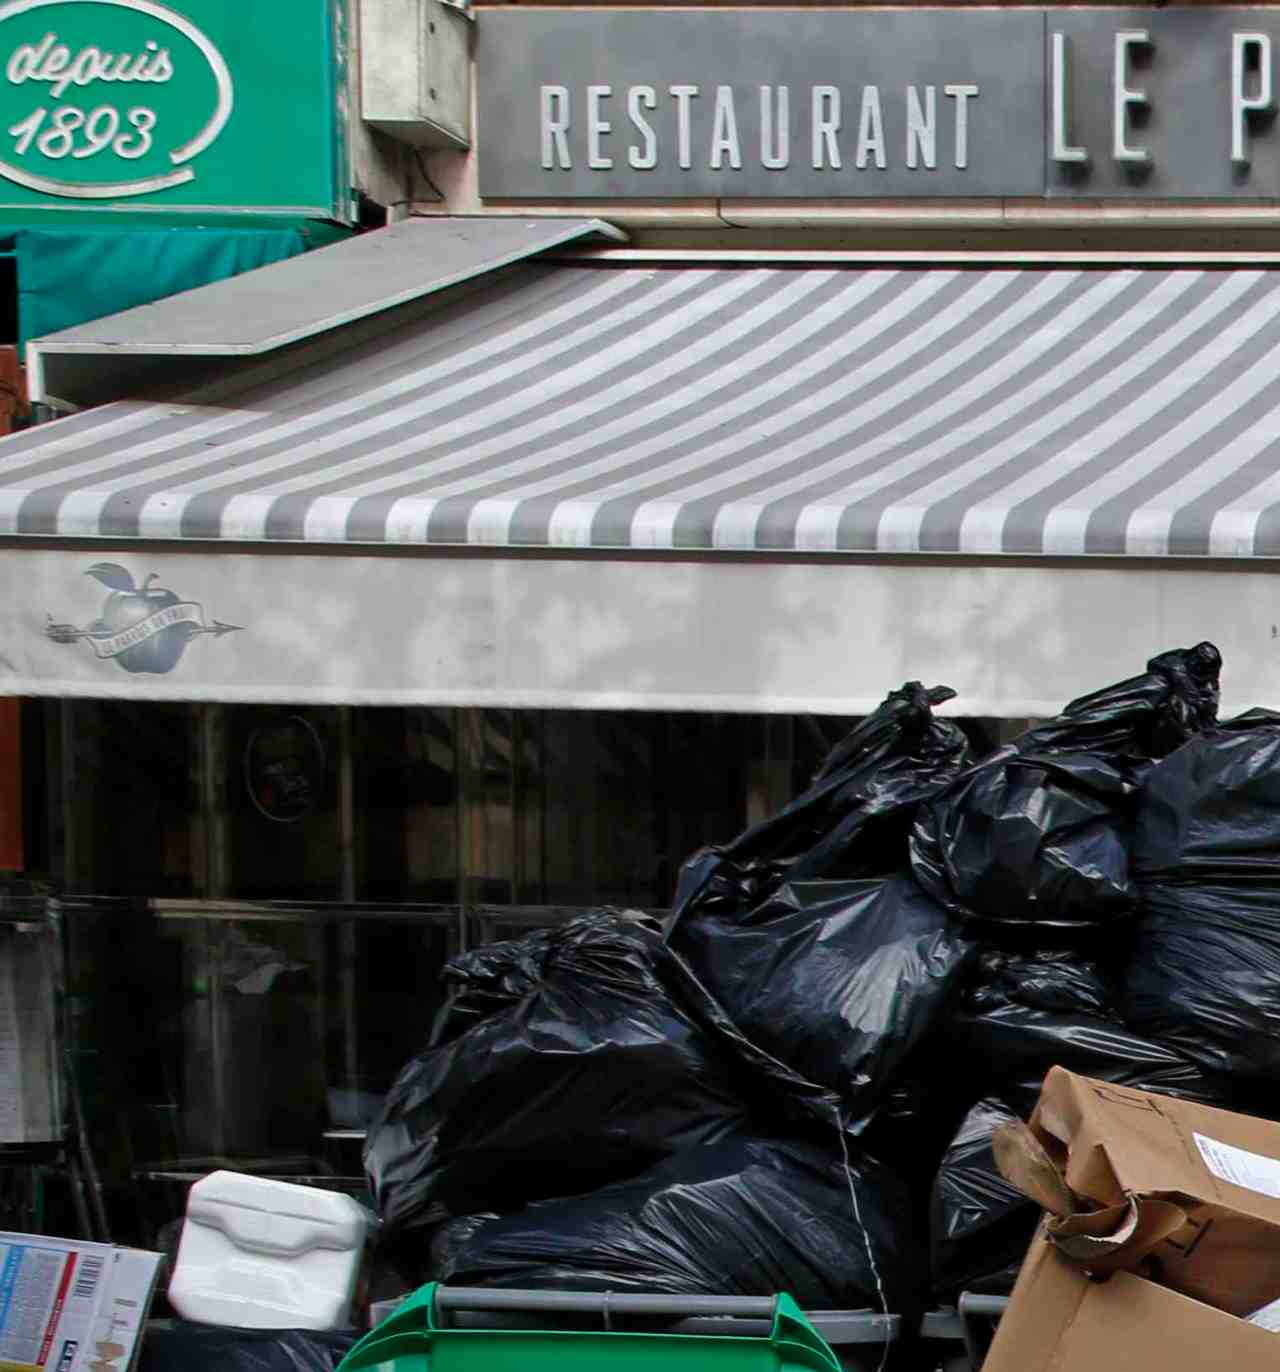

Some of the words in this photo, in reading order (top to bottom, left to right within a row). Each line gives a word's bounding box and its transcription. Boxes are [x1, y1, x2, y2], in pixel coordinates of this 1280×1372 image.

[6, 31, 172, 98] depuis
[1050, 30, 1152, 168] LE
[9, 105, 156, 161] 1893
[540, 84, 979, 170] RESTAURANT
